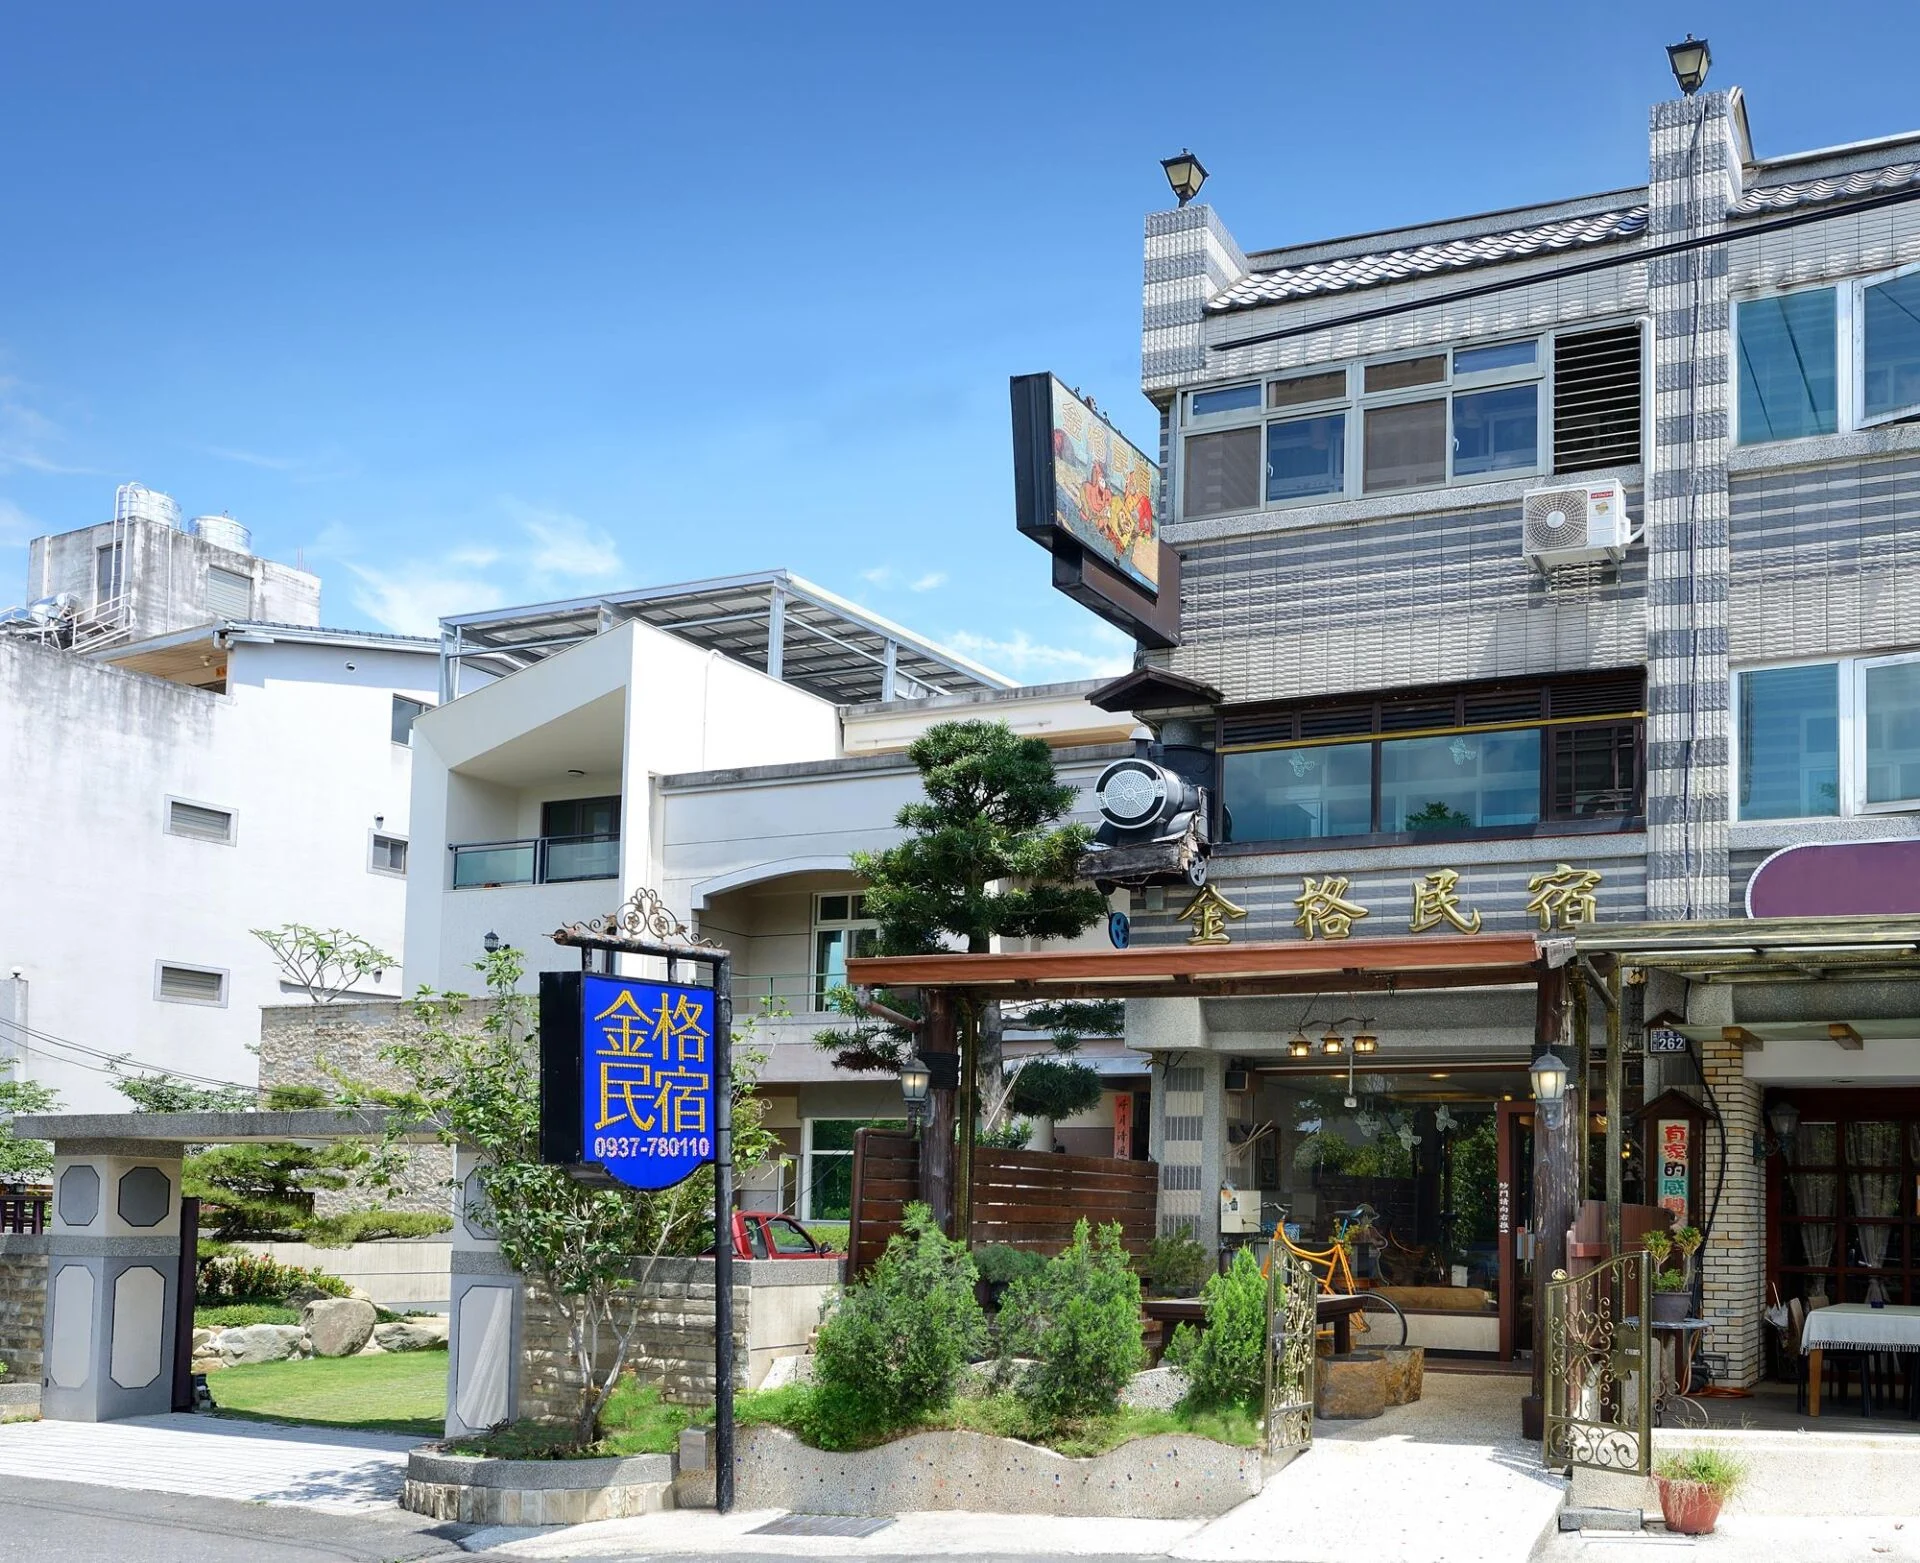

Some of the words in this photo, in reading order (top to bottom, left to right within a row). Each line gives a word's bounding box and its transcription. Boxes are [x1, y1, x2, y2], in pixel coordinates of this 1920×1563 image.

[1176, 864, 1603, 945] 金格民宿
[594, 989, 710, 1063] 金格
[1659, 1037, 1684, 1050] 262
[594, 1061, 709, 1134] 民宿
[594, 1136, 709, 1158] 0937-780110
